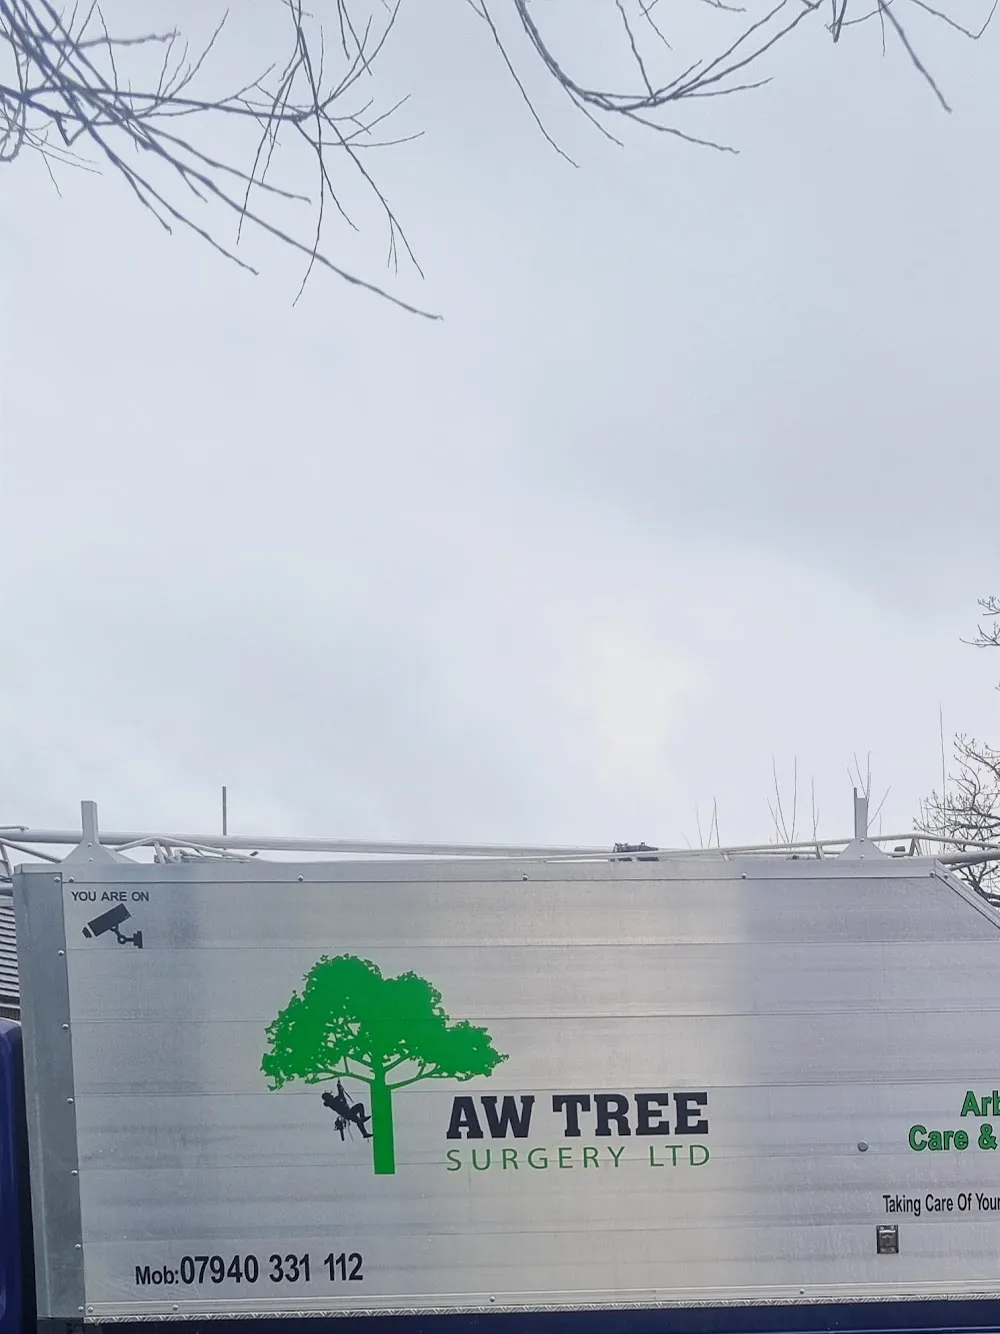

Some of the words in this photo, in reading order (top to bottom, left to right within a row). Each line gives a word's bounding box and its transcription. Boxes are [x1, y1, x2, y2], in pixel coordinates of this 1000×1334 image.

[71, 891, 98, 903] YOU
[100, 891, 128, 903] ARE
[131, 891, 150, 903] ON
[446, 1095, 536, 1140] AW
[551, 1091, 710, 1138] TREE
[908, 1124, 969, 1152] Care
[978, 1124, 998, 1150] &
[446, 1145, 626, 1172] SURGERY
[649, 1144, 711, 1167] LTD
[882, 1194, 922, 1217] Taking
[925, 1194, 954, 1213] Care
[957, 1193, 973, 1212] Of
[268, 1253, 311, 1284] 331
[323, 1252, 364, 1283] 112
